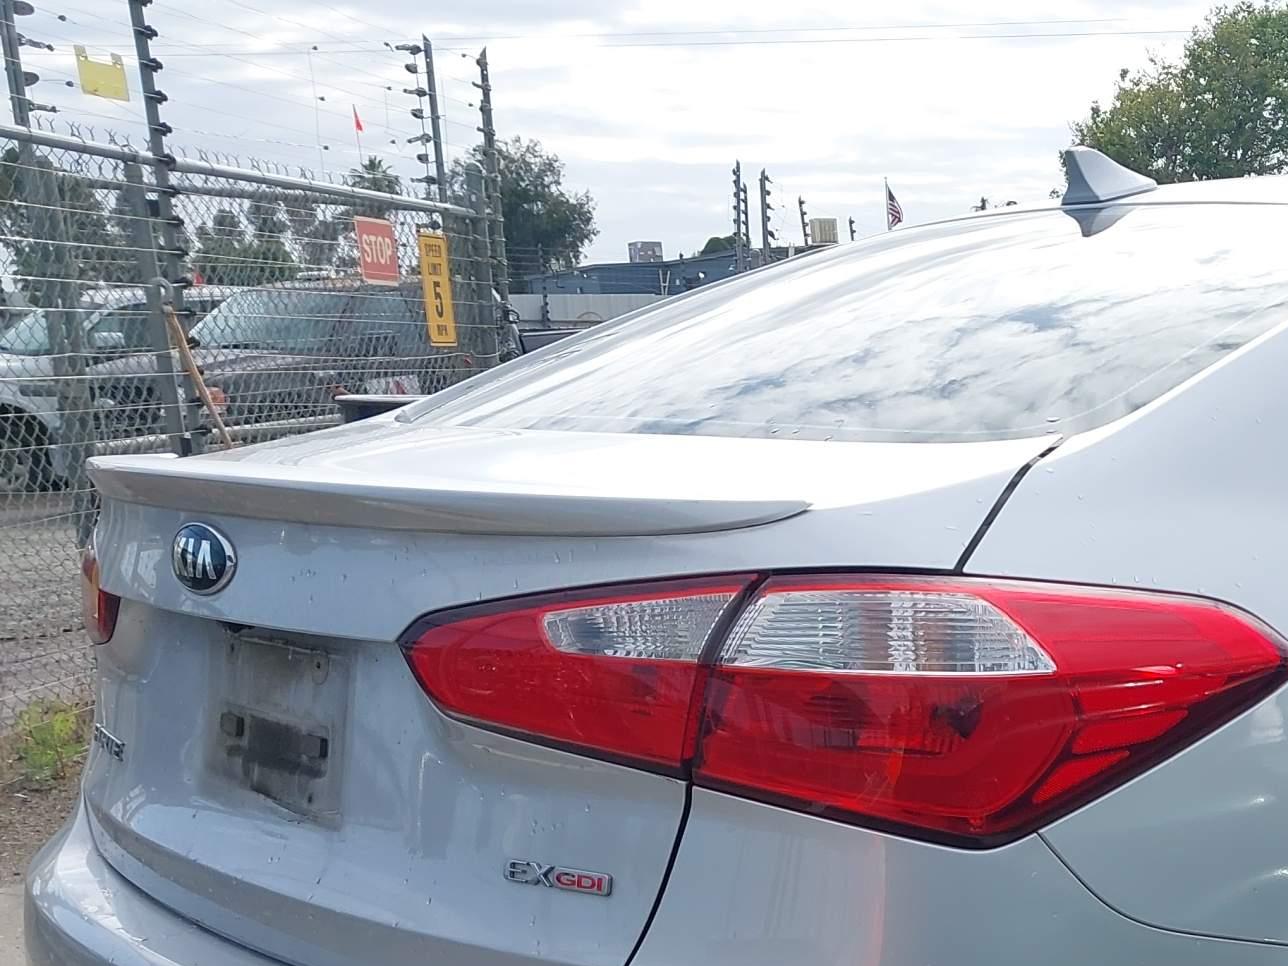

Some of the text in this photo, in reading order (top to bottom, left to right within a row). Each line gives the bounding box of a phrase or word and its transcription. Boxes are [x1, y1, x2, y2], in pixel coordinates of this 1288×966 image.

[361, 234, 393, 265] STOP
[424, 243, 441, 258] SPEED
[428, 262, 442, 276] LIMIT
[432, 280, 444, 319] 5
[436, 324, 449, 337] MPH
[173, 535, 217, 580] KIA
